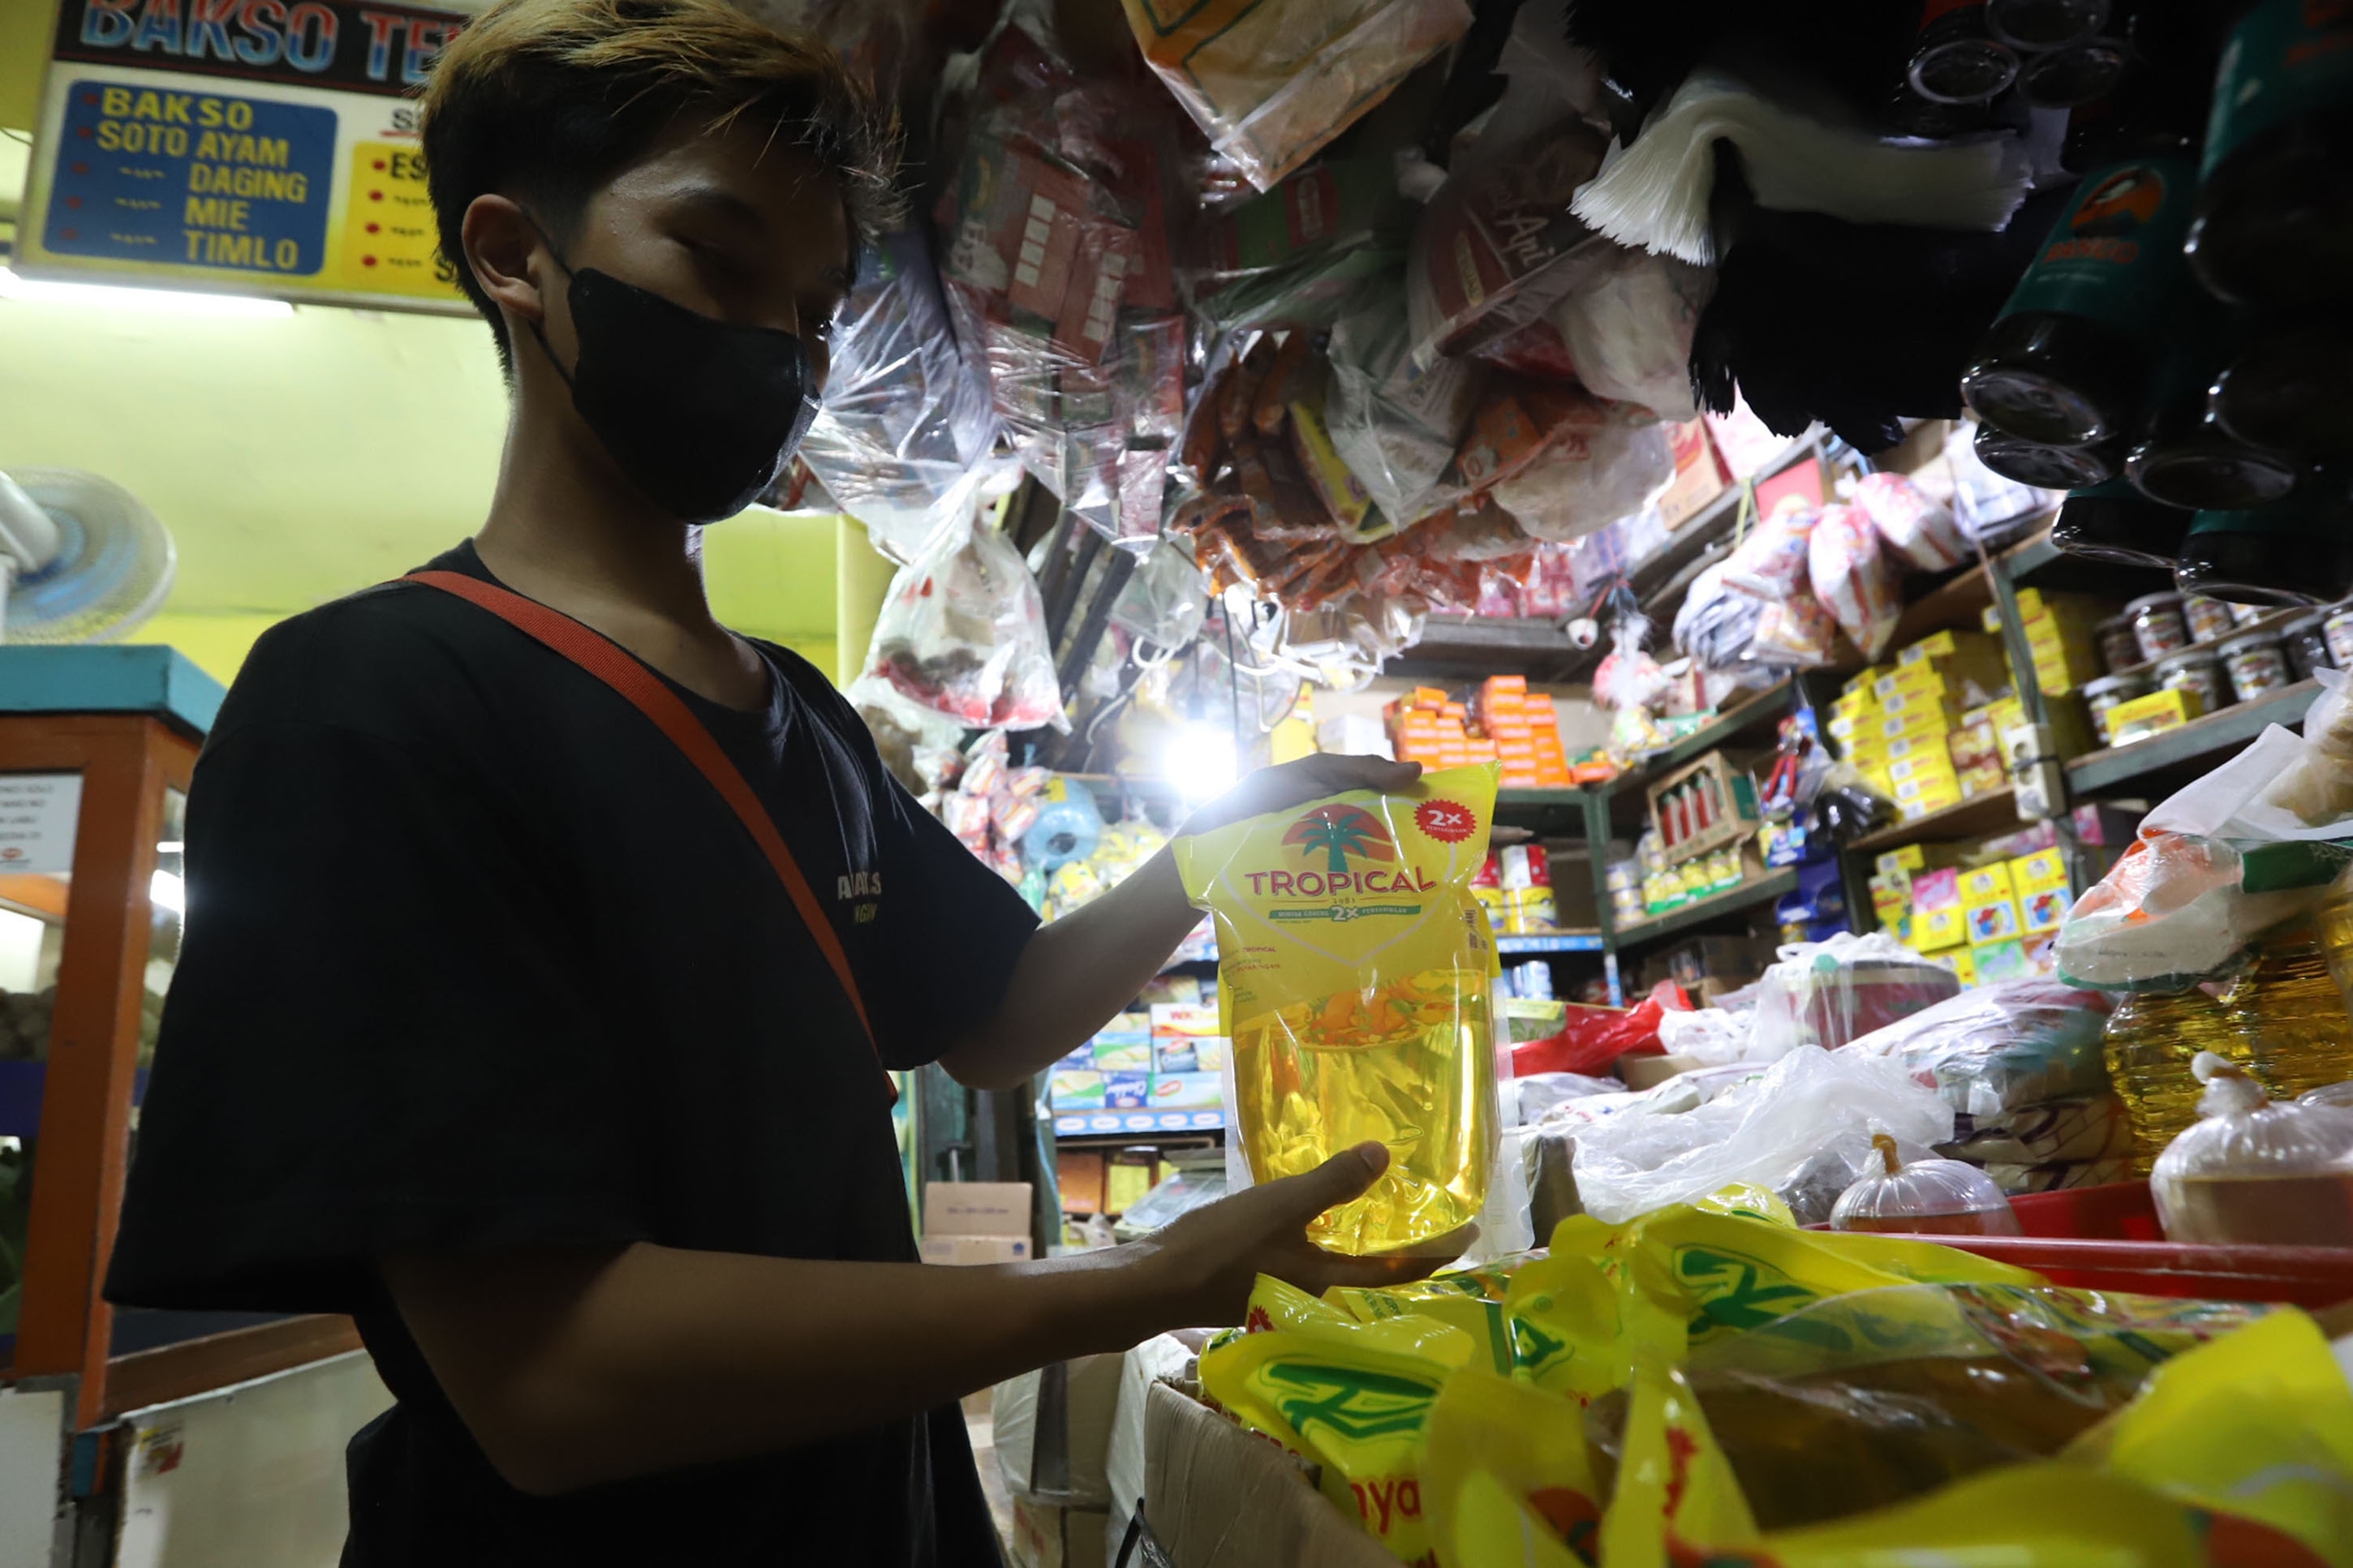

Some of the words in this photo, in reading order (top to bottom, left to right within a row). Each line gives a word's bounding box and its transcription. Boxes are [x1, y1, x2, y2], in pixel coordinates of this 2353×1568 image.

[81, 0, 338, 72] BAKSO
[97, 121, 188, 157] SOTO
[196, 134, 289, 169] AYAM
[188, 162, 308, 203] DAGING
[183, 198, 251, 231] MIE
[183, 230, 298, 270] TIMLO
[1427, 810, 1463, 826] 2x
[1245, 866, 1436, 897] TROPICAL
[1331, 904, 1359, 921] 2x
